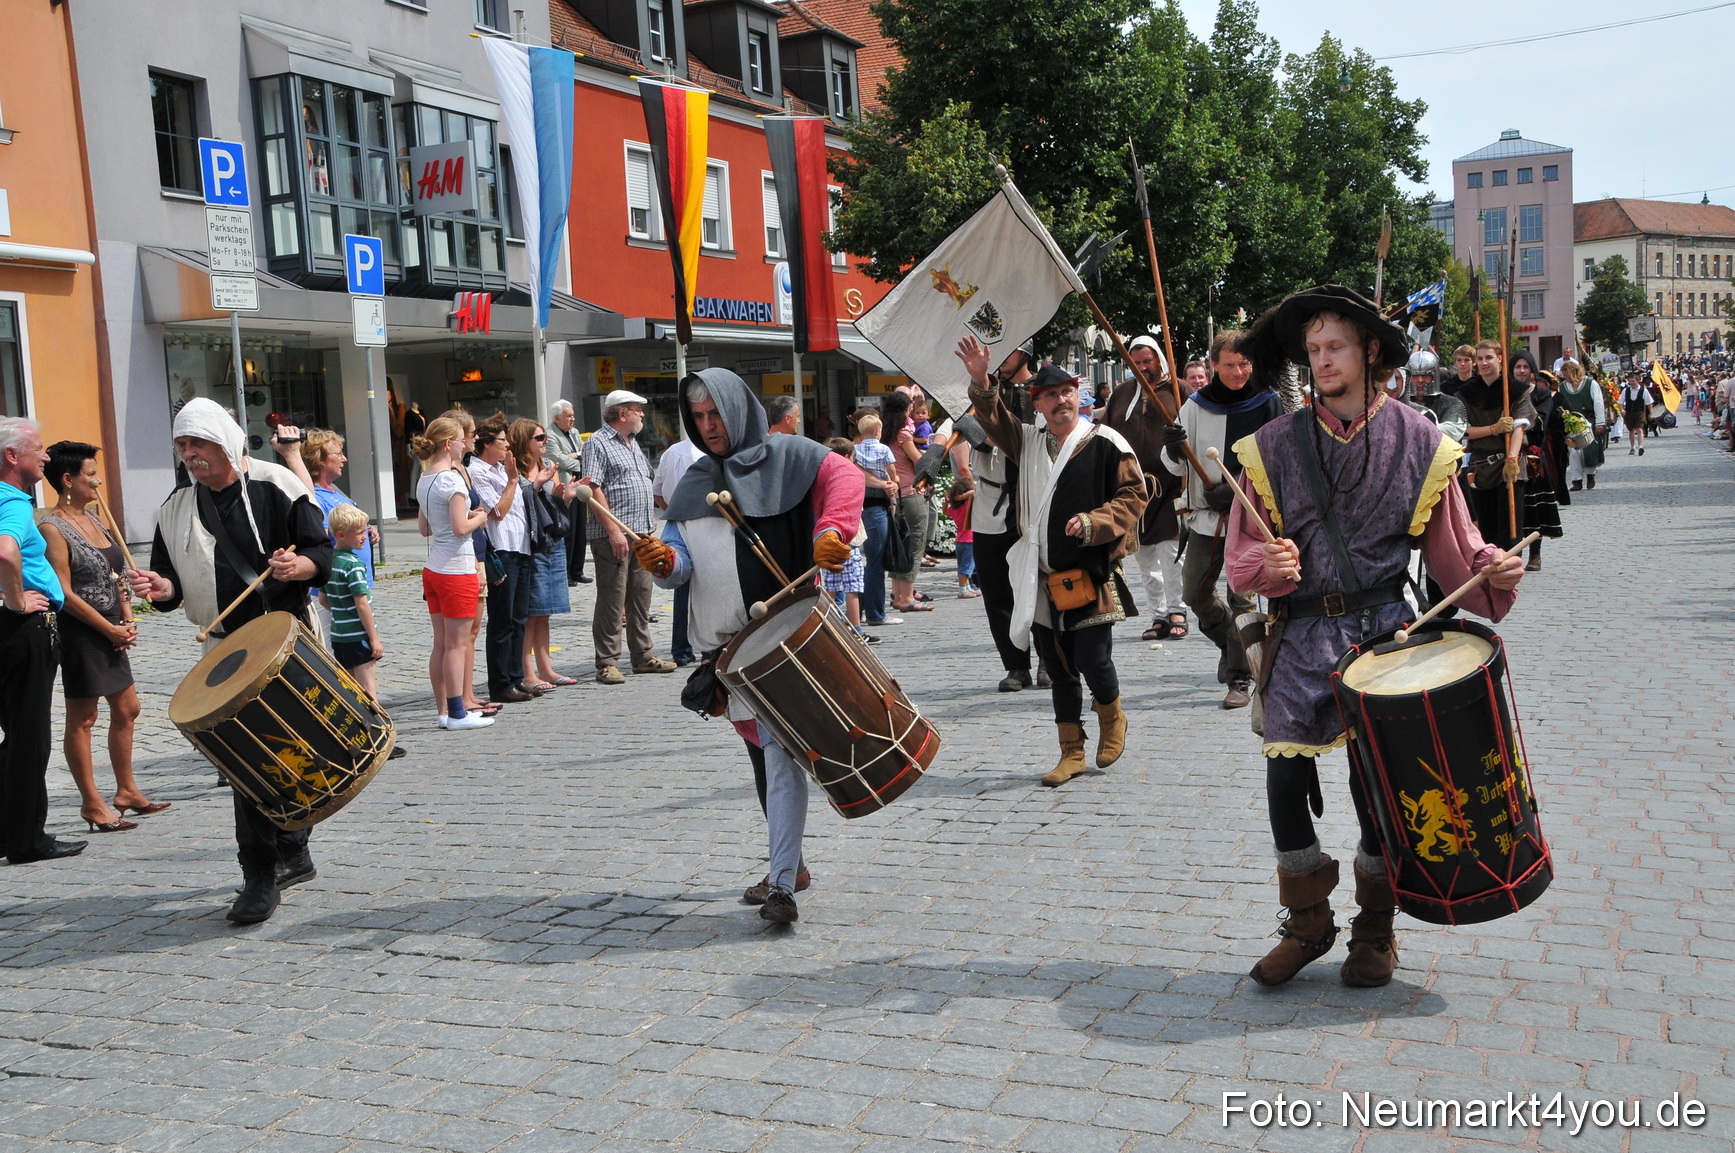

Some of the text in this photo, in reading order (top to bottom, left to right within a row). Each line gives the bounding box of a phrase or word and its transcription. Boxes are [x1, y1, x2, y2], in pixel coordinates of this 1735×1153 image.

[210, 148, 236, 197] P
[417, 155, 464, 200] H&M
[230, 215, 242, 223] mit
[210, 222, 249, 234] Parkschein
[214, 234, 247, 246] werktags
[212, 257, 221, 266] Sa
[354, 243, 375, 287] P
[455, 291, 492, 335] H&M
[598, 376, 614, 384] LOTTO
